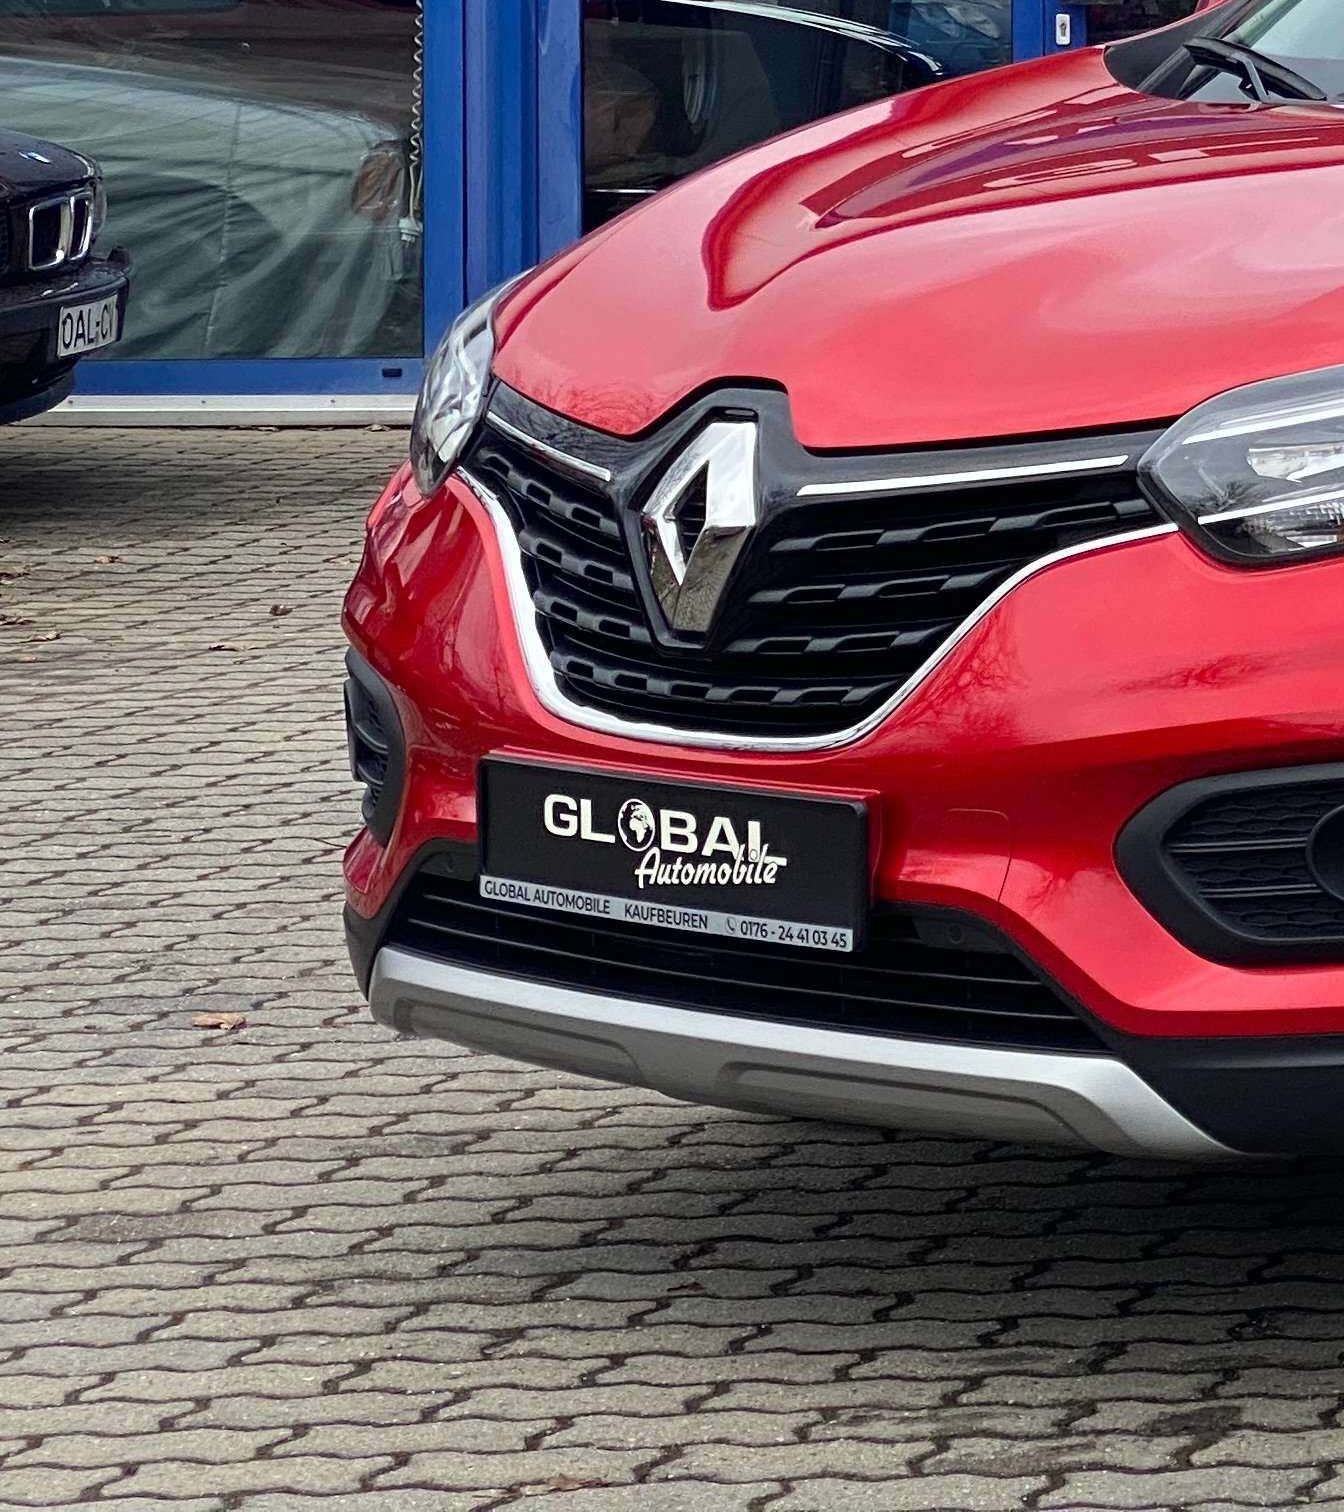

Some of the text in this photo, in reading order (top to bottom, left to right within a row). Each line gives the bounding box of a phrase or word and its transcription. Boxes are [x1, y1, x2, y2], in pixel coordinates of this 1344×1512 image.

[543, 793, 787, 867] GLOBAL
[634, 842, 779, 889] Automobile
[484, 879, 531, 903] GLOBAL
[533, 888, 610, 916] AUTOMOBILE
[624, 903, 708, 930] KAUFBEUREN
[740, 920, 768, 939] 0176
[778, 925, 795, 943] 24
[796, 927, 809, 944] 41
[812, 929, 828, 947] 03
[830, 931, 847, 949] 45
